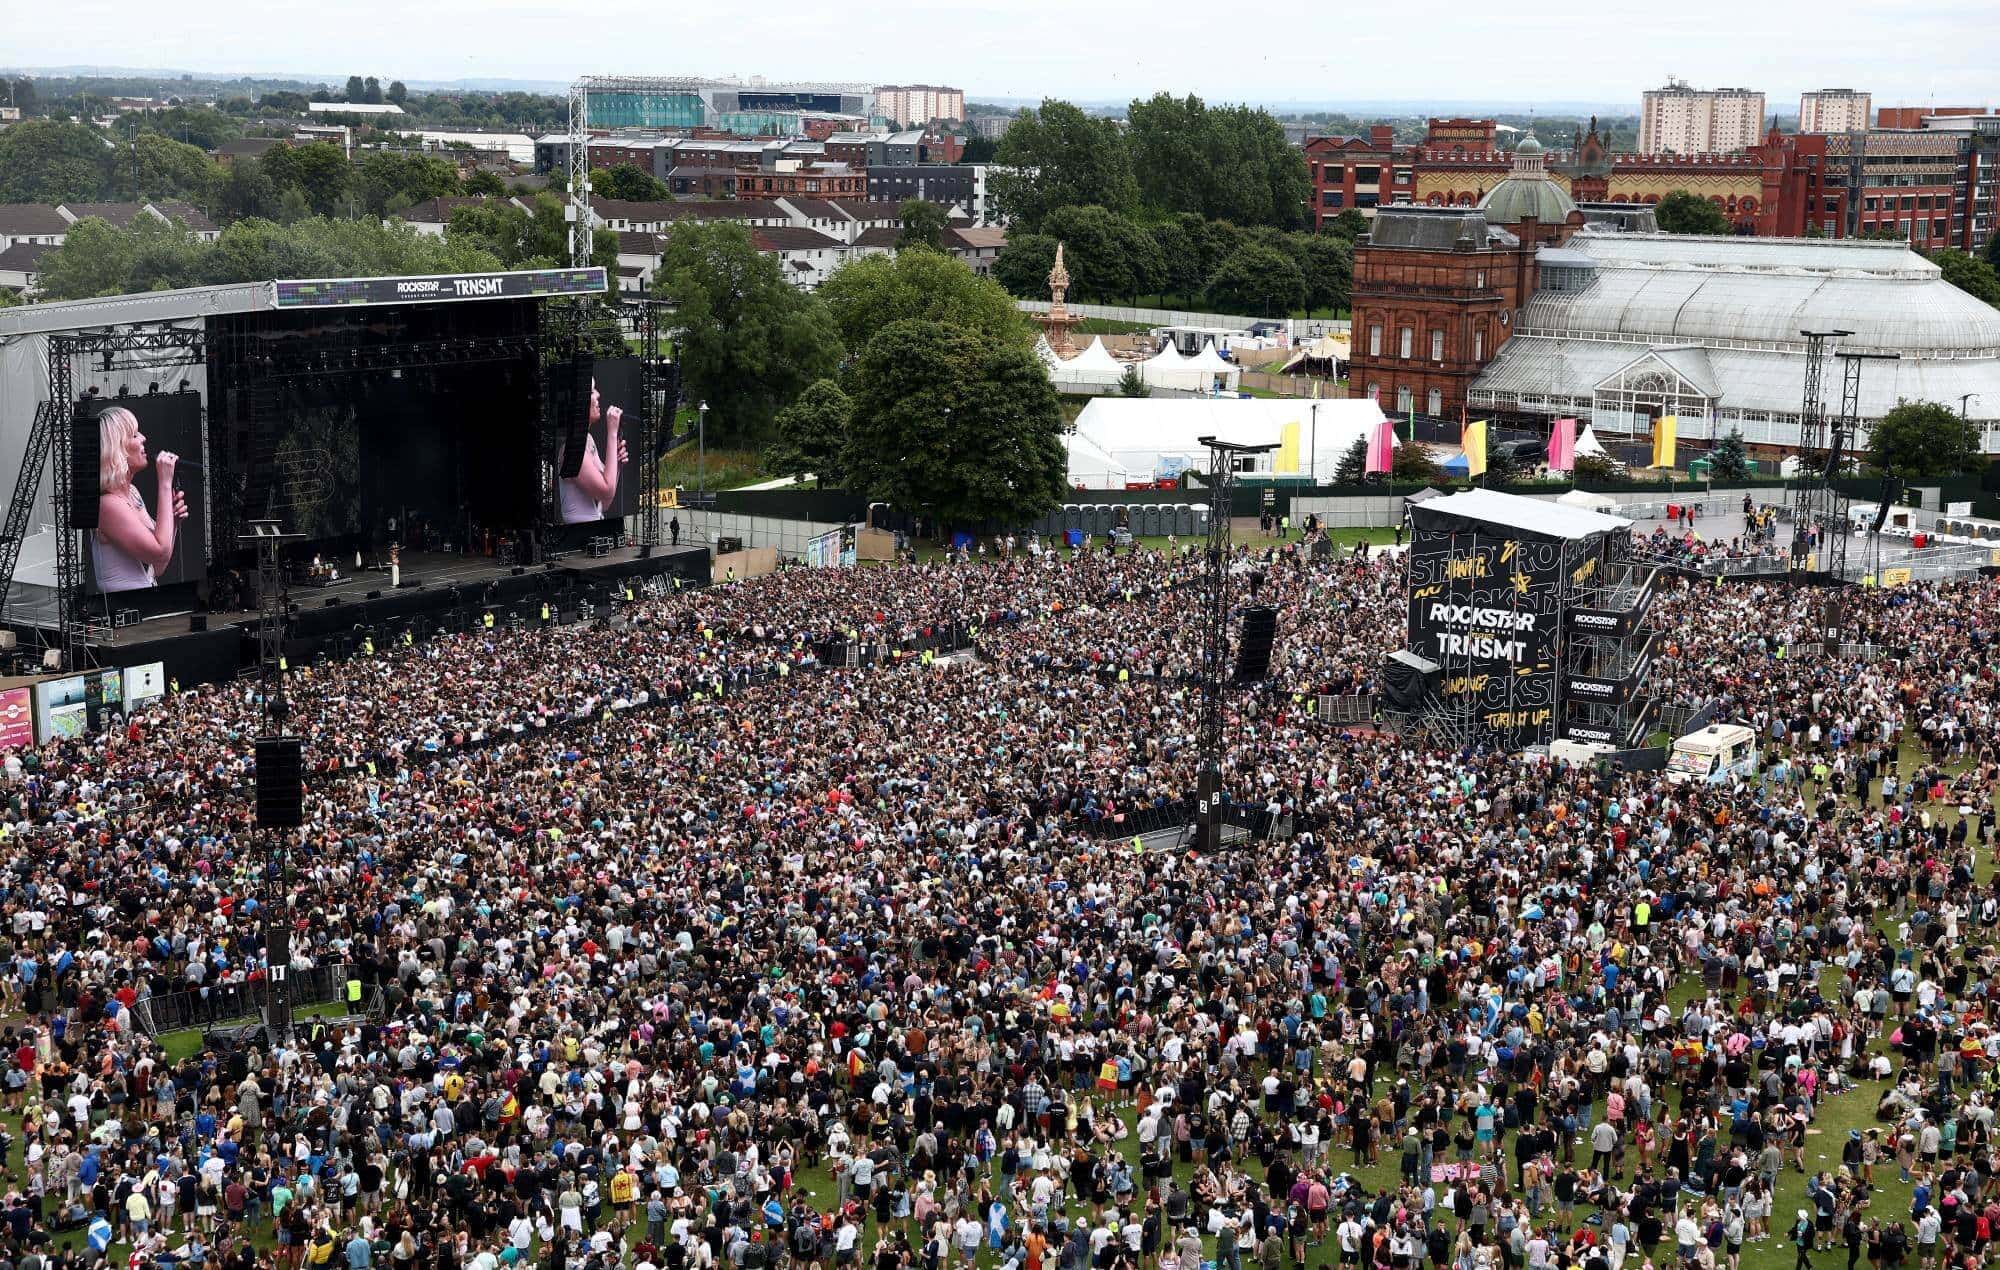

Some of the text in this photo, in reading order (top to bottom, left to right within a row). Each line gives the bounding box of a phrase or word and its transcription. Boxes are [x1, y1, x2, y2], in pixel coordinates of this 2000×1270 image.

[397, 278, 504, 296] ROCKSTAR TRNSMT
[1429, 603, 1536, 632] ROCKSTAR
[1575, 614, 1618, 626] ROCKSTAR
[1436, 632, 1527, 662] TRNSMT
[1571, 681, 1614, 694] ROCKSTAR
[1568, 727, 1611, 741] ROCKSTAR
